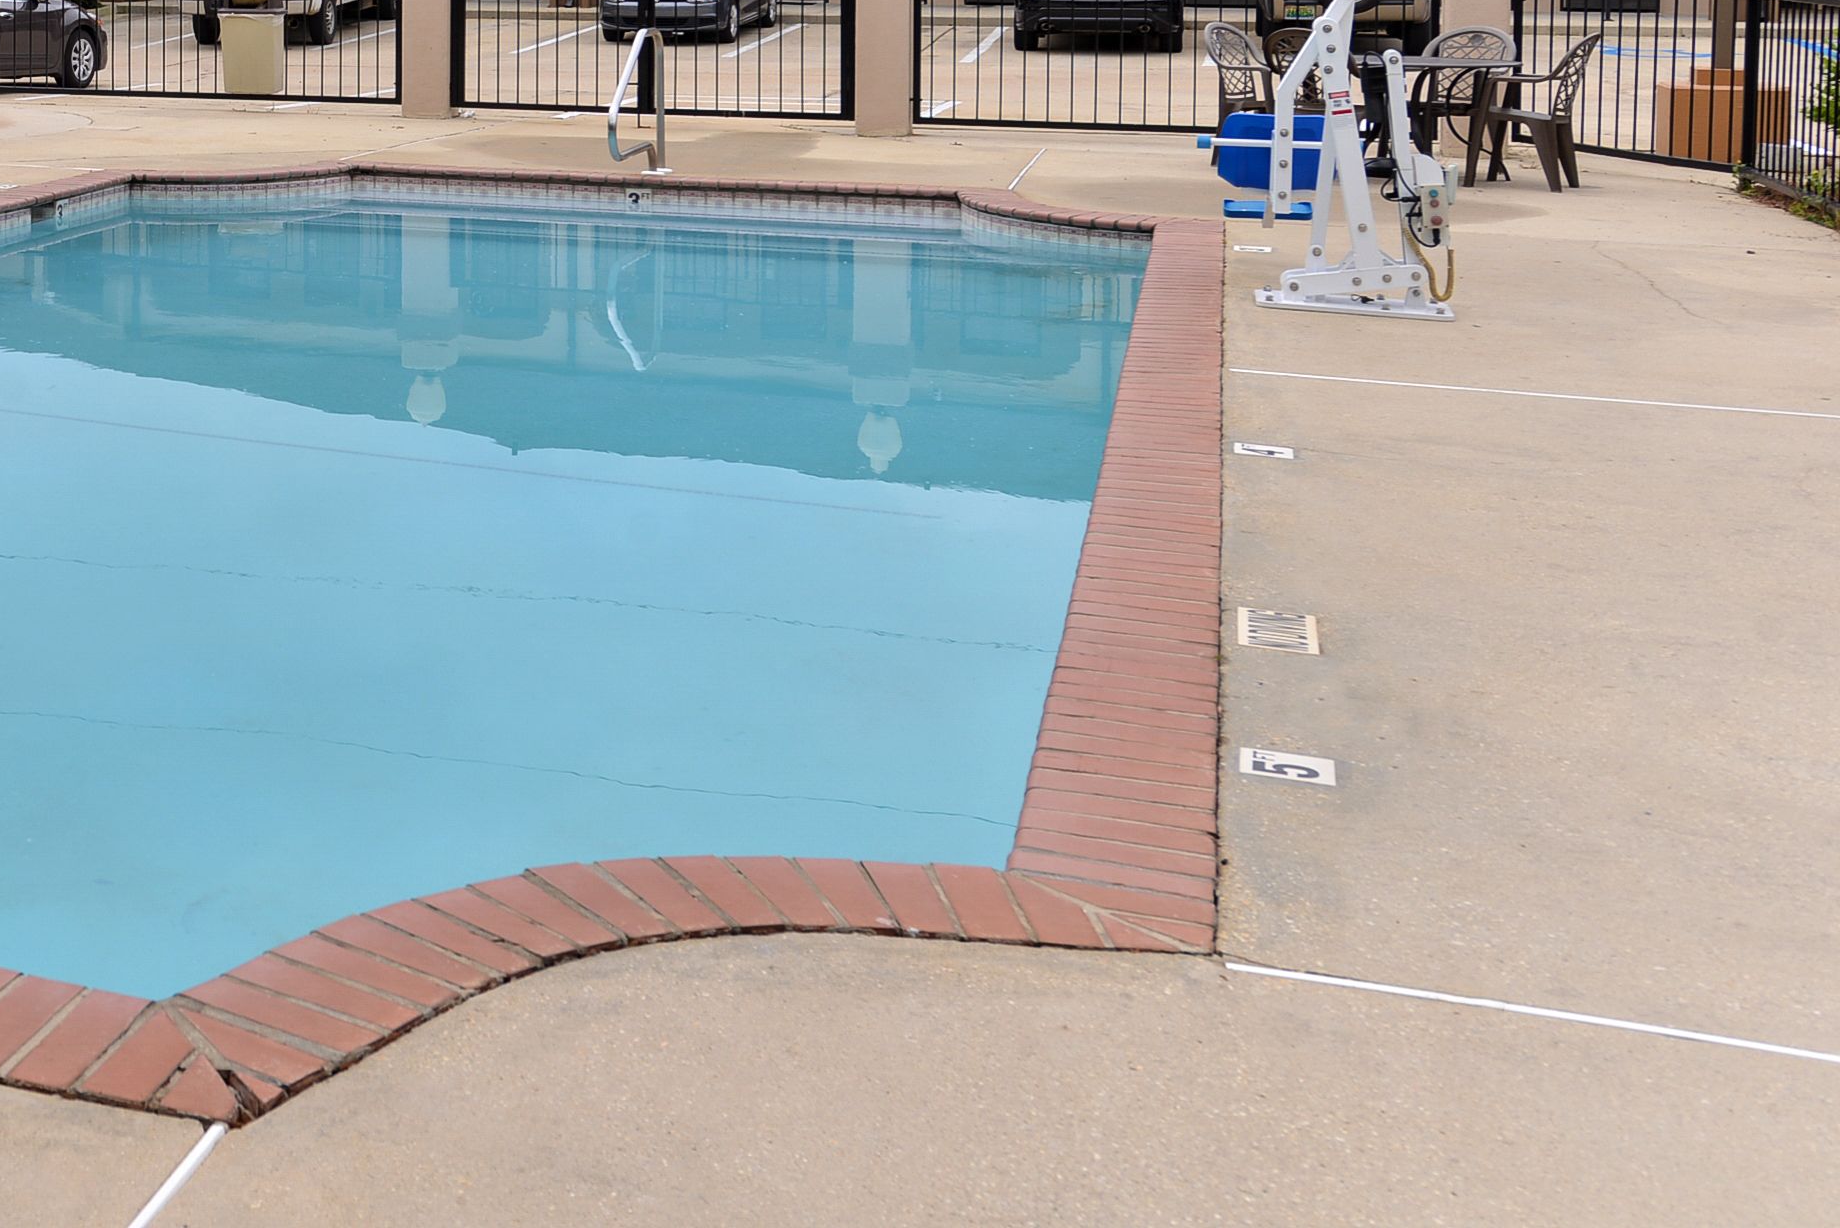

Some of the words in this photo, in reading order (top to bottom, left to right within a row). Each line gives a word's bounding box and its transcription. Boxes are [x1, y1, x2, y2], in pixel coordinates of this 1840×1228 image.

[628, 192, 640, 204] 3
[1252, 750, 1276, 762] FT
[1252, 759, 1320, 779] 5
